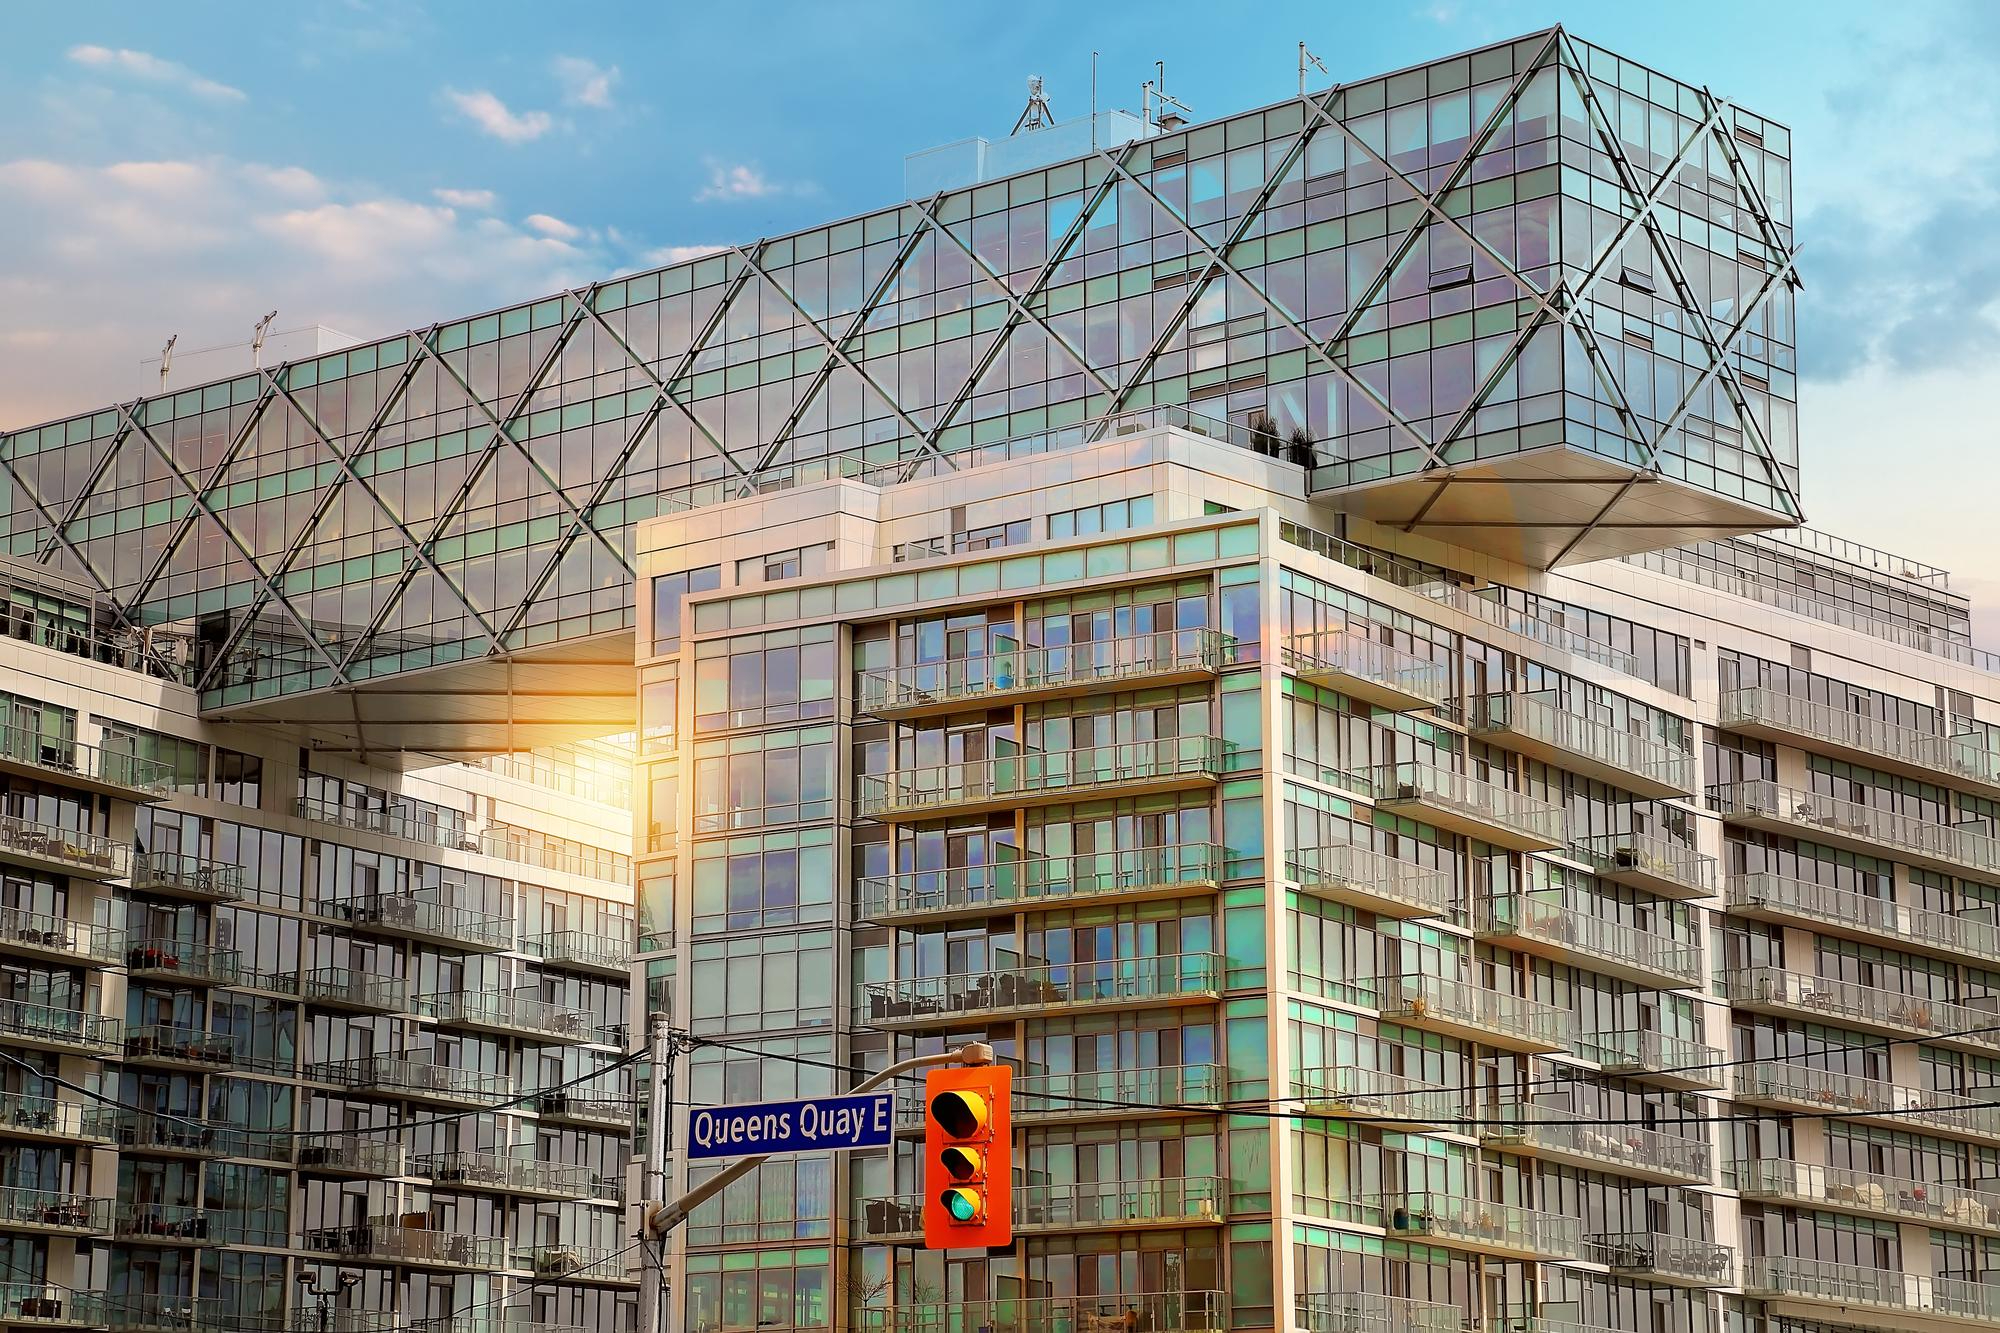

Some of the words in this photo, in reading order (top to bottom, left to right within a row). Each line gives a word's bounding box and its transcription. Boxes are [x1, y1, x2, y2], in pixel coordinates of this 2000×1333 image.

[694, 1111, 791, 1149] Queens
[799, 1103, 866, 1143] Quay
[873, 1098, 888, 1132] E
